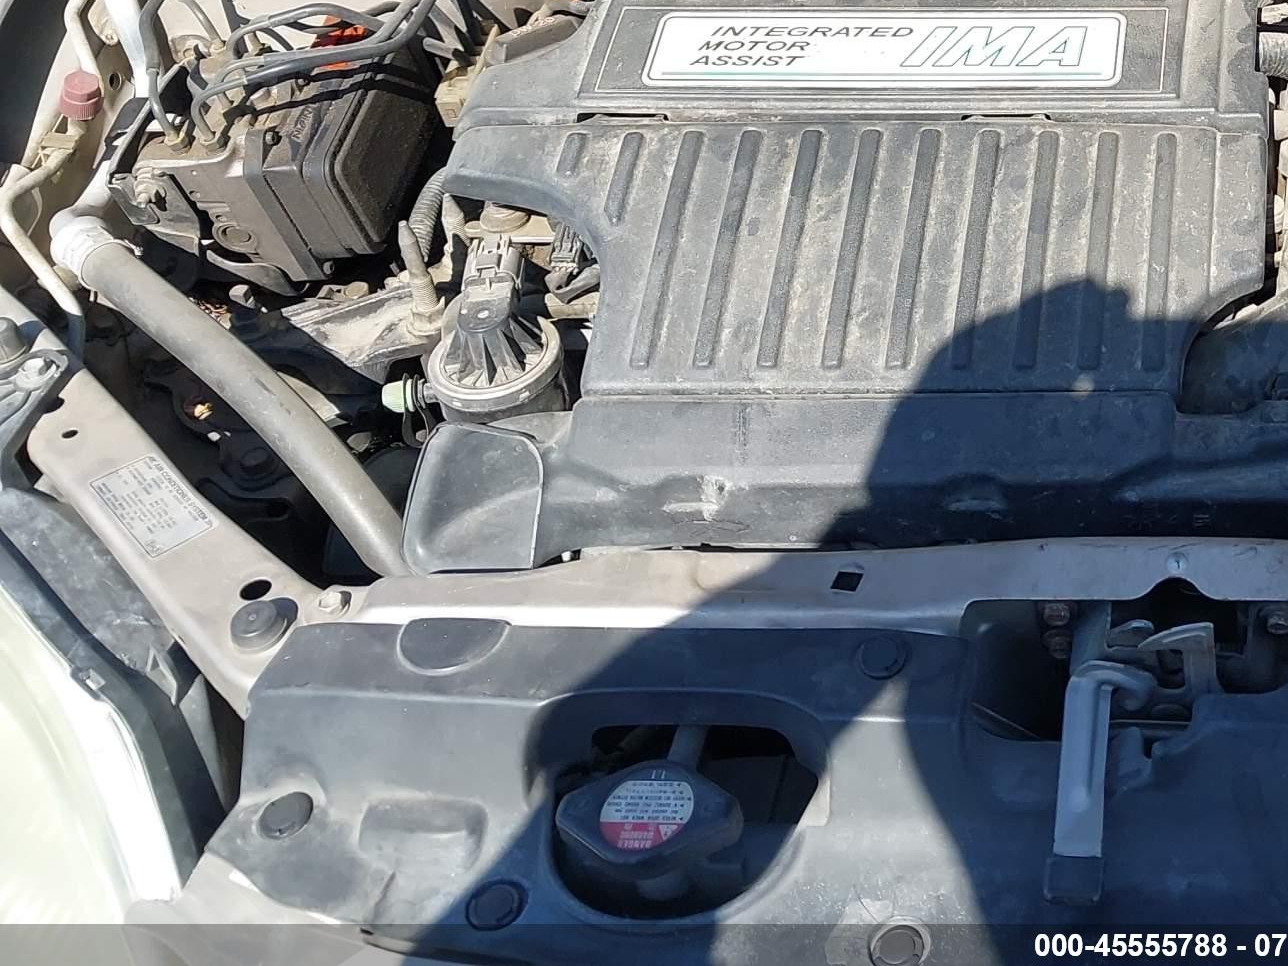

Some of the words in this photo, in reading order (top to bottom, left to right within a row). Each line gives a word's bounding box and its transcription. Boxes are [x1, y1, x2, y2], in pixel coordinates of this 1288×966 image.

[711, 25, 914, 38] INTEGRATED
[698, 40, 811, 52] MOTOR
[900, 25, 1089, 68] IMA
[689, 54, 807, 67] ASSIST
